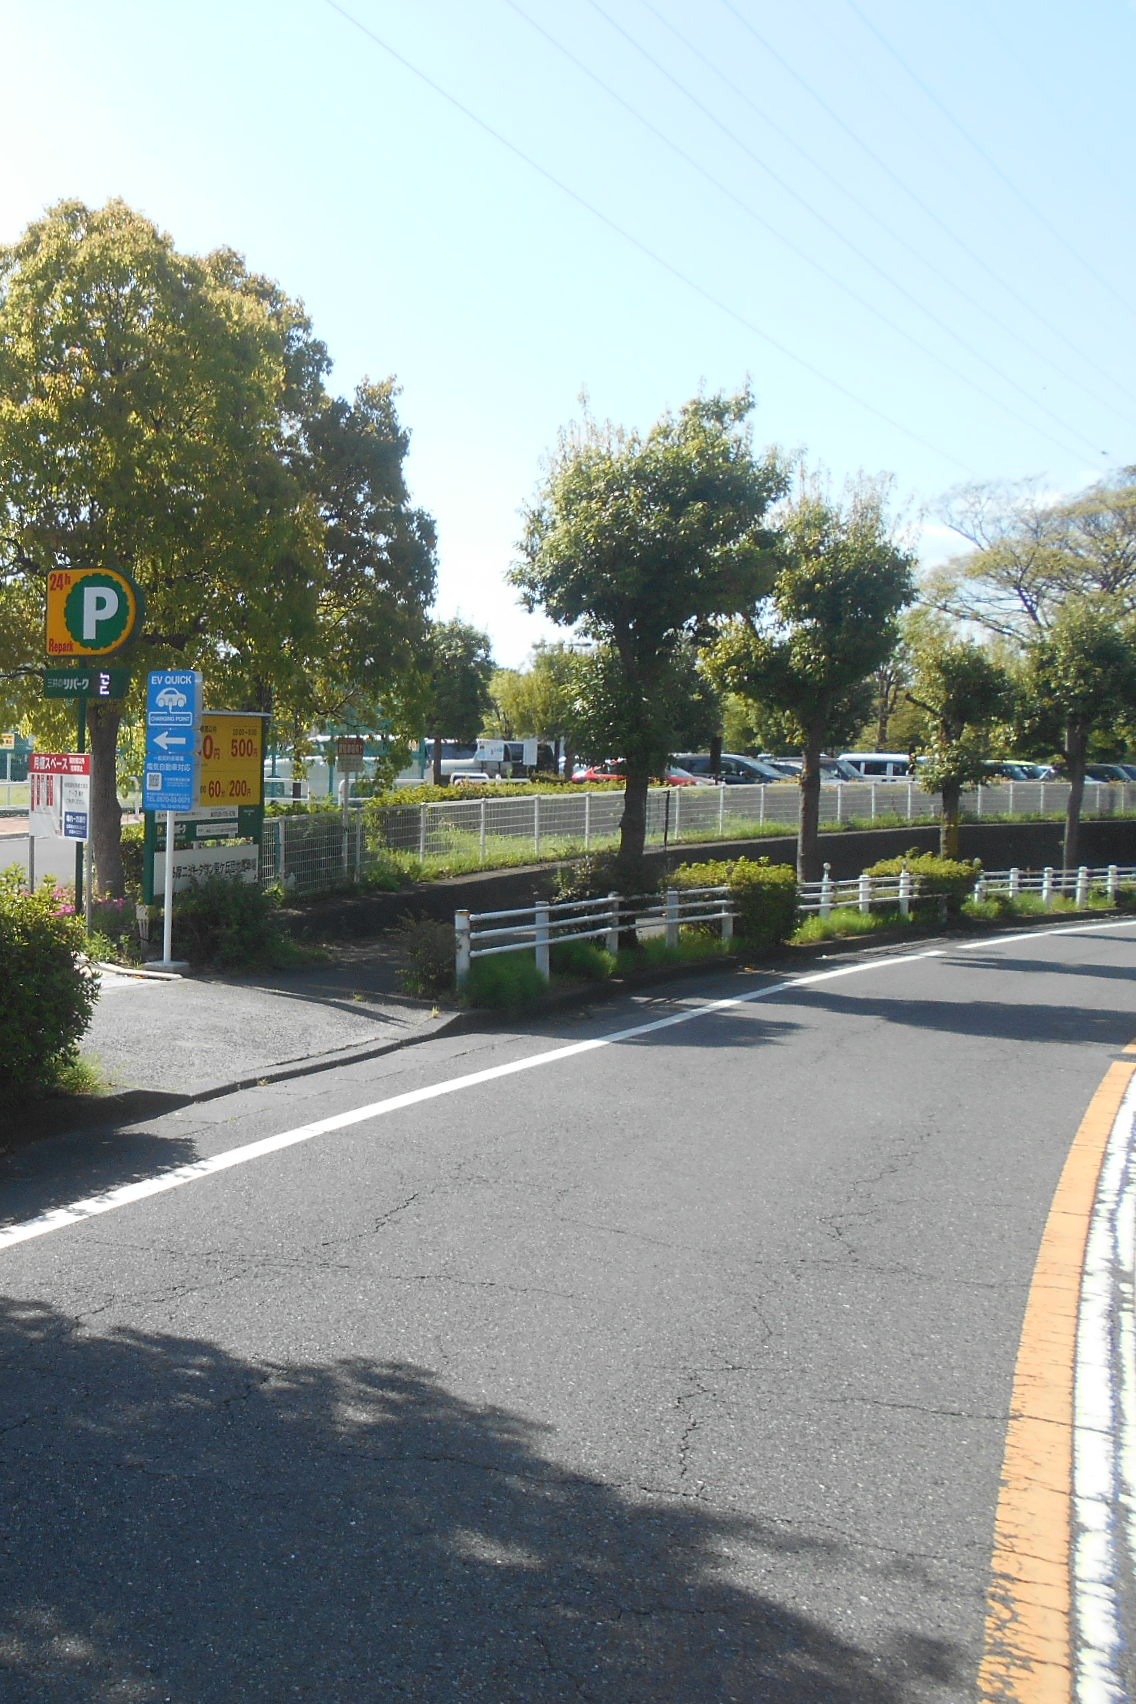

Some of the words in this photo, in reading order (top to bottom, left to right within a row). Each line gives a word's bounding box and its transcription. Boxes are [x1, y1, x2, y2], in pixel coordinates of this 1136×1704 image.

[49, 573, 71, 591] 24h
[83, 586, 119, 640] P
[48, 638, 74, 654] Repark
[151, 675, 163, 685] EV
[164, 675, 192, 685] QUICK
[231, 738, 258, 757] 500円
